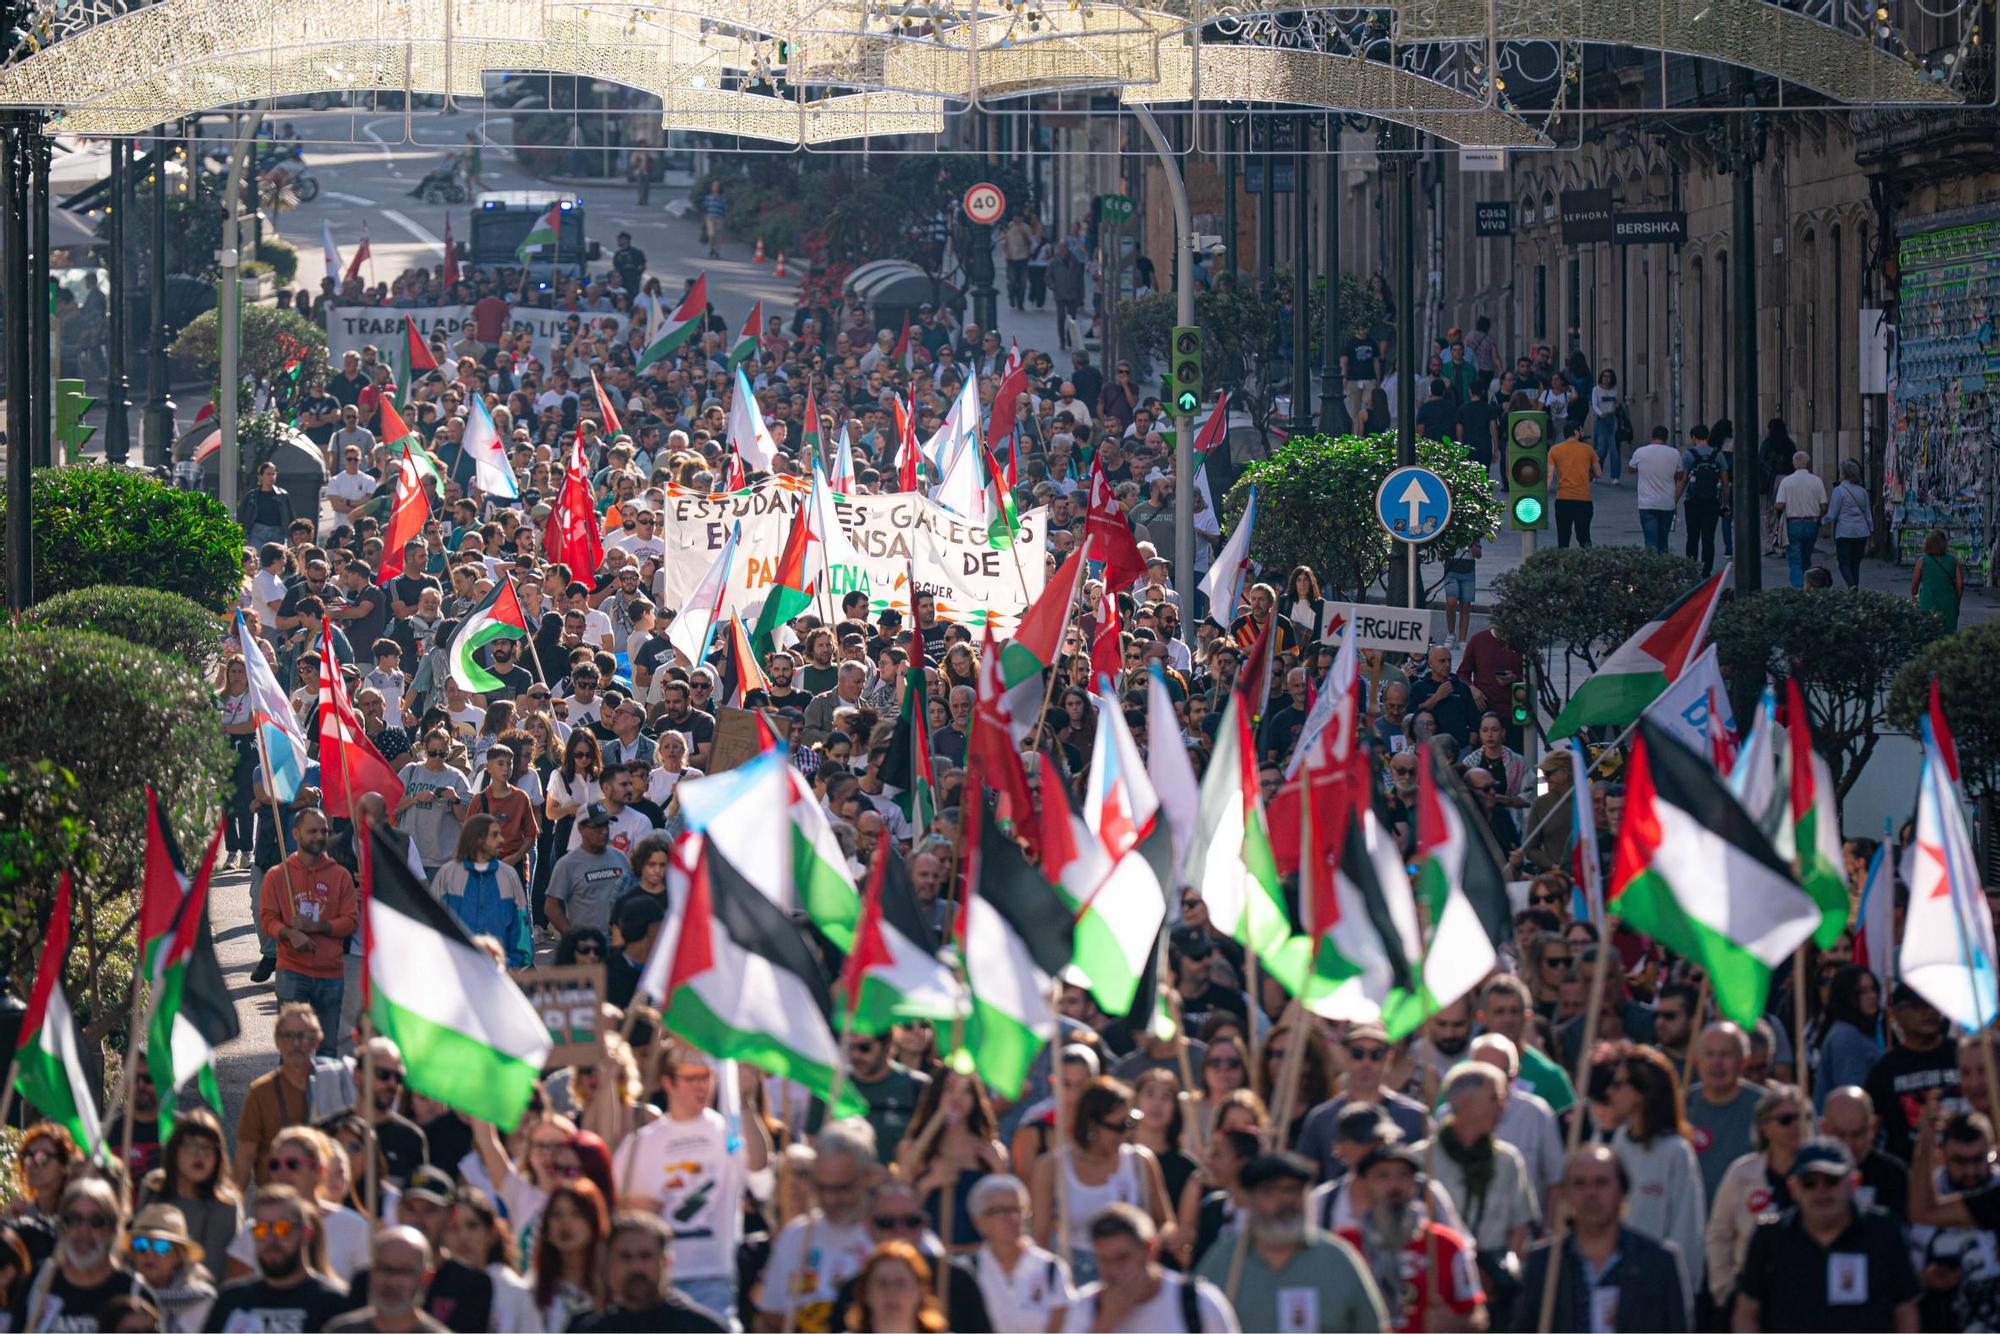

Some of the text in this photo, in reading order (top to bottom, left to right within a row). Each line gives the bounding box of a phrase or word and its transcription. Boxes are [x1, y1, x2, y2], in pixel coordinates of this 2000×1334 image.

[973, 195, 997, 209] 40
[1479, 208, 1507, 218] casa
[1563, 210, 1609, 223] SEPHORA
[1480, 220, 1506, 230] viva
[1616, 221, 1680, 235] BERSHKA
[890, 504, 1034, 546] GALEGS
[963, 551, 1000, 577] DE
